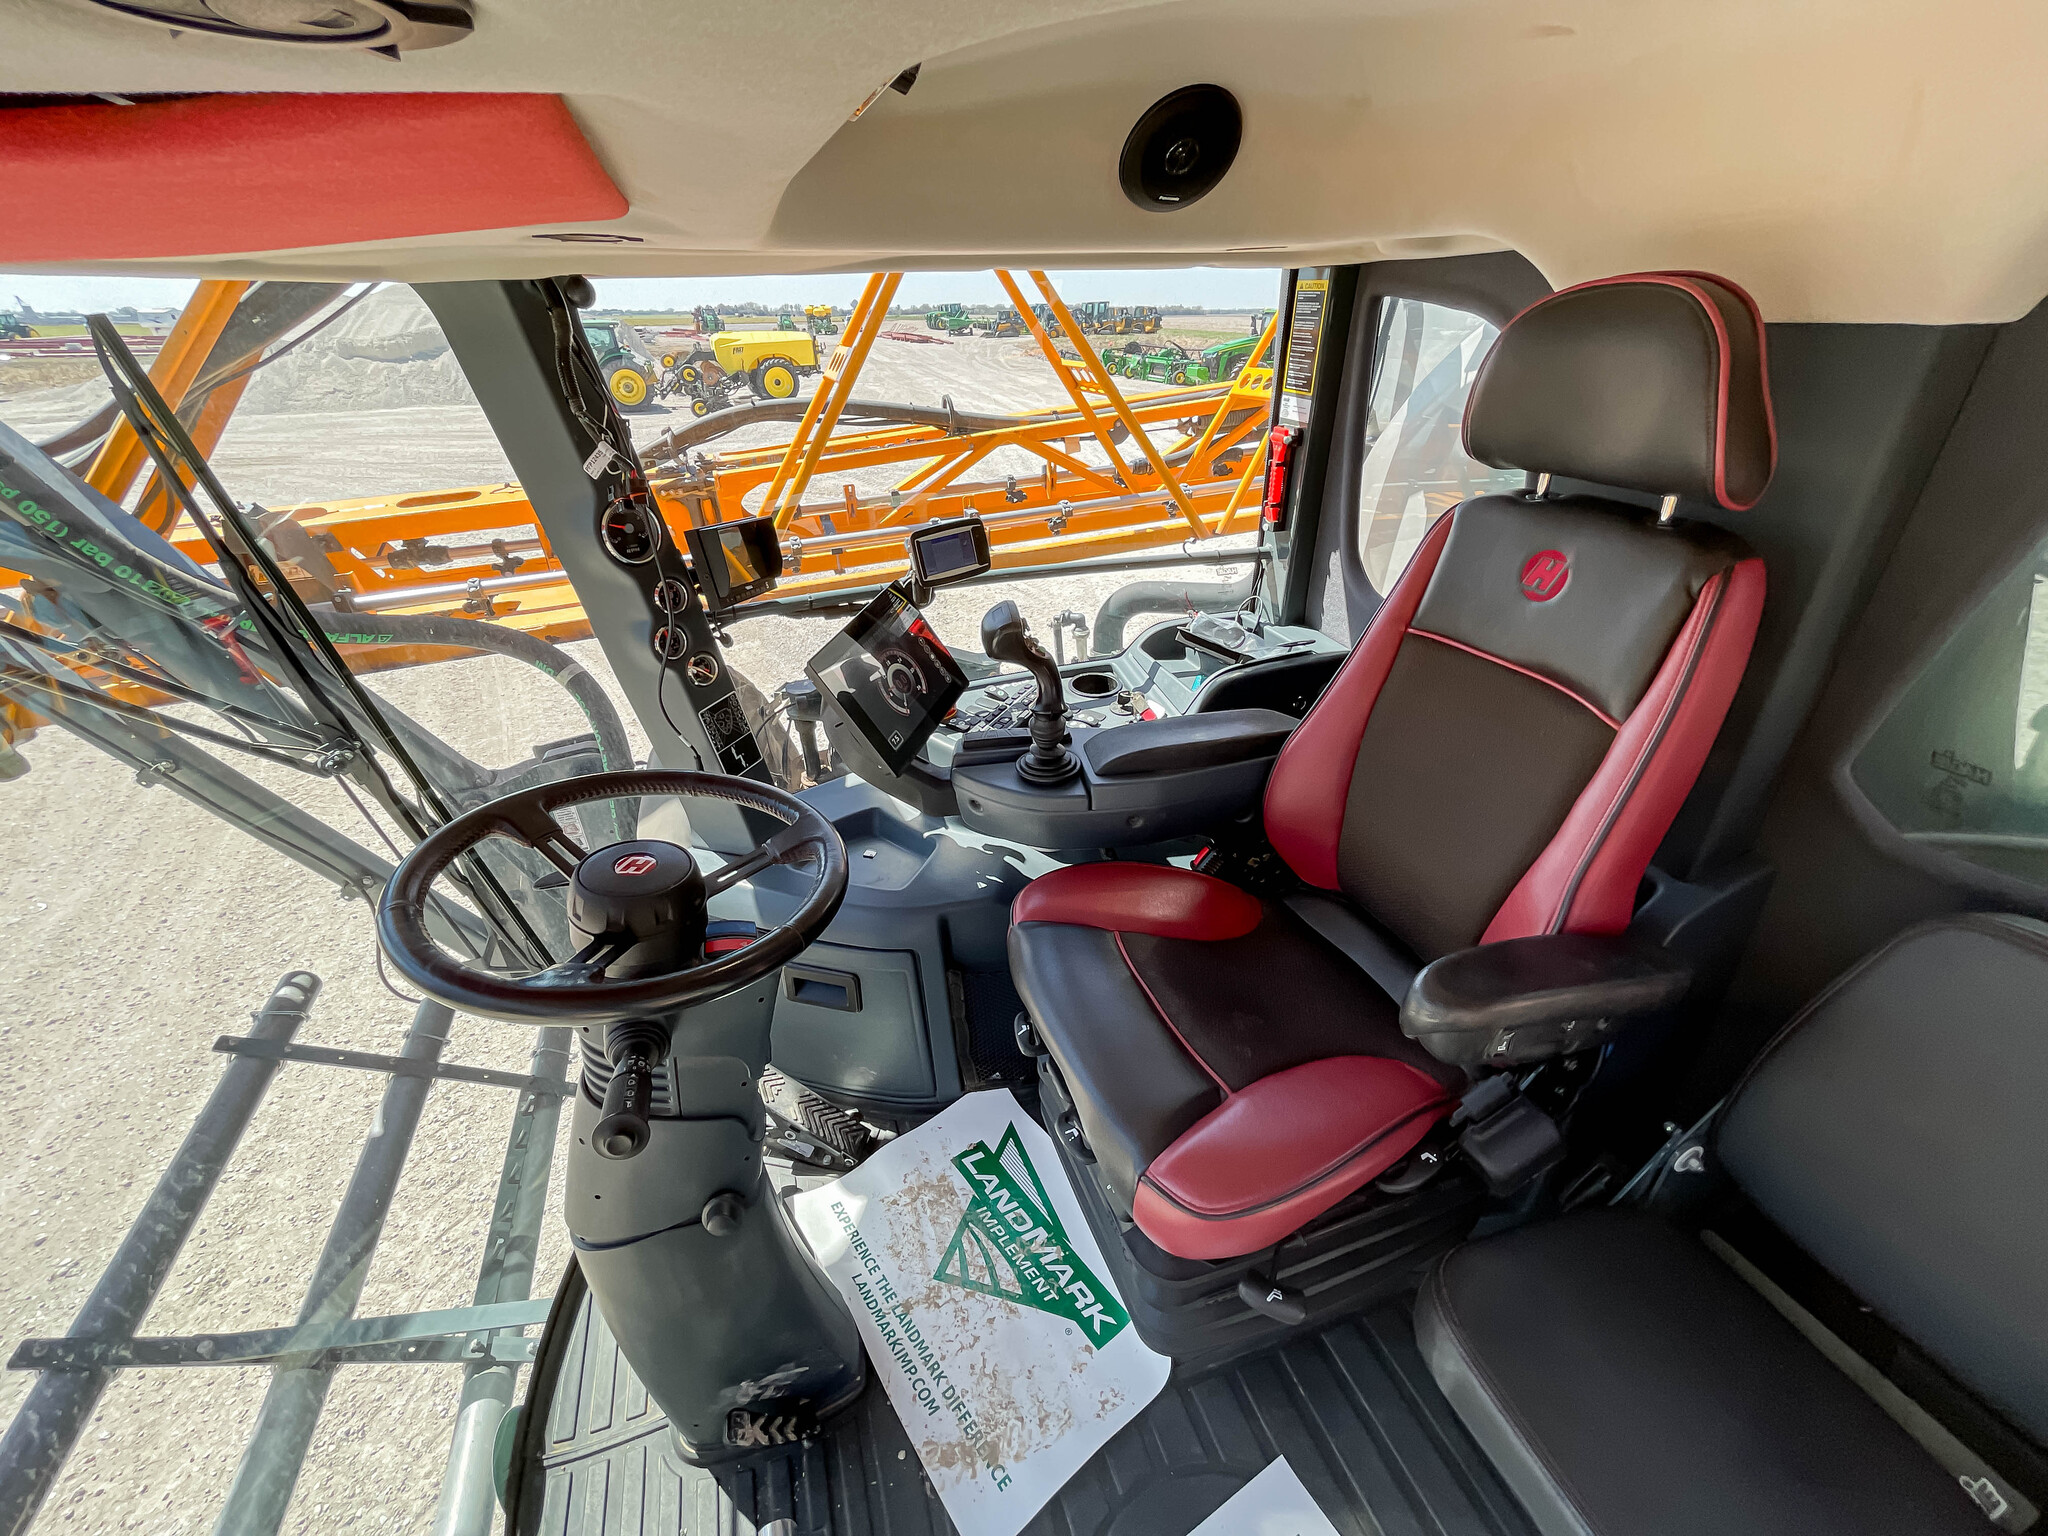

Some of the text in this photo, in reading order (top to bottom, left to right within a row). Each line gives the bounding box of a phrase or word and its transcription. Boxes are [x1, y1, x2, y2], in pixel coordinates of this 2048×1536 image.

[70, 538, 114, 567] bar
[830, 1200, 877, 1276] EXPERIENCE
[876, 1272, 898, 1306] THE
[892, 1301, 946, 1388] LANDMARK
[961, 1151, 1118, 1340] LANDMARK
[975, 1206, 1059, 1302] IMPLEMENT
[851, 1273, 940, 1417] LANDMARKIMP.COM
